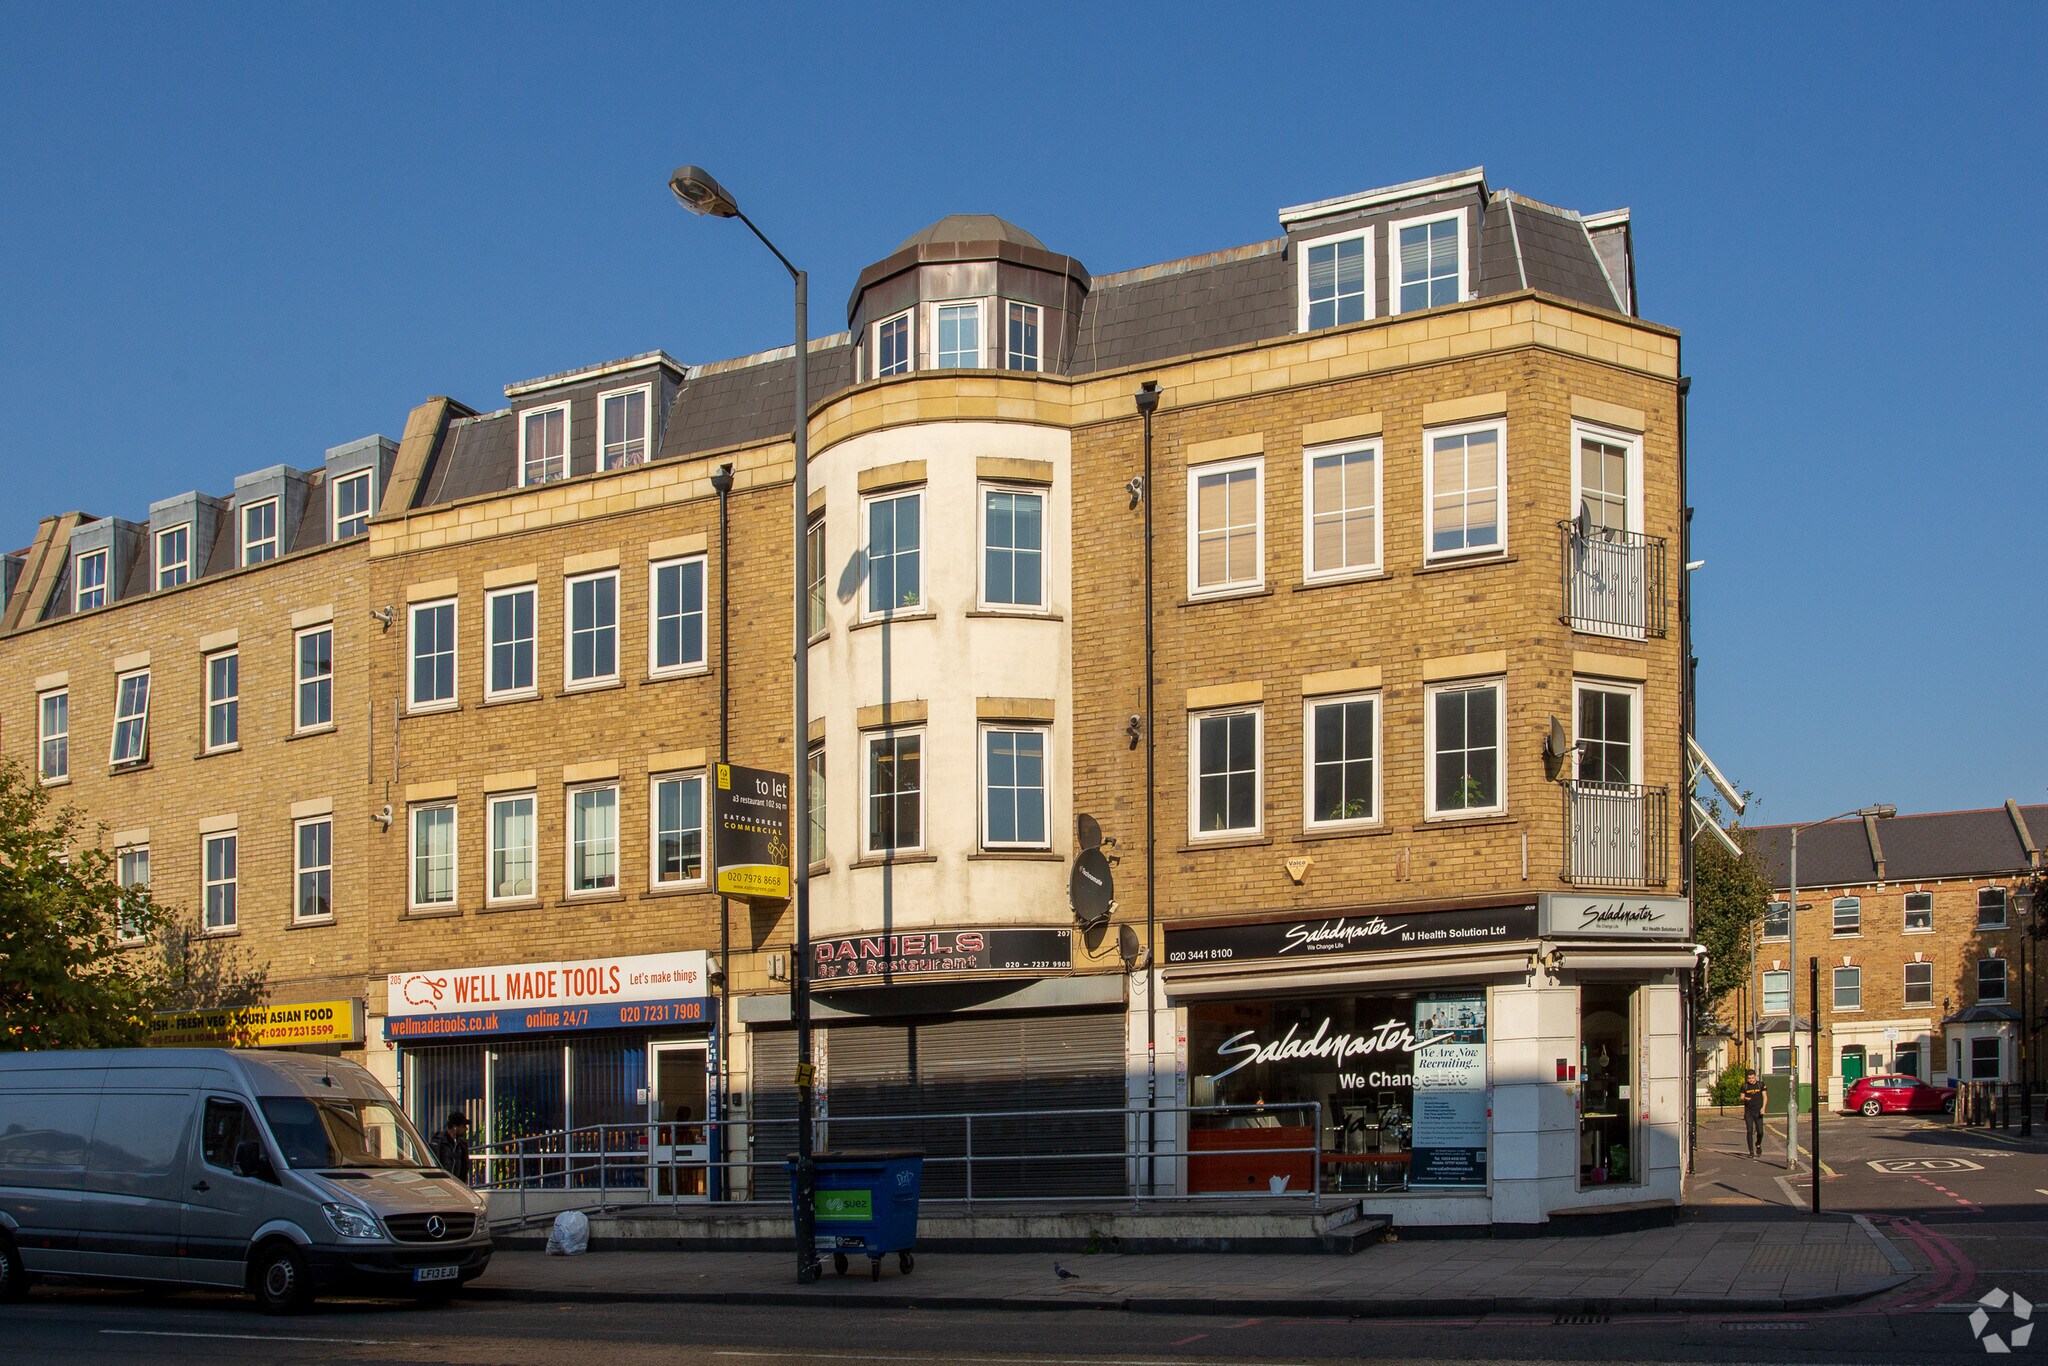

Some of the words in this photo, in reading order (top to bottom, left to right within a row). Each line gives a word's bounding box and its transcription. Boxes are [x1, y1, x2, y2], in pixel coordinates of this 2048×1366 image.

[756, 778, 769, 795] to
[772, 778, 787, 798] let
[732, 794, 740, 802] a3
[740, 797, 765, 806] restaurant
[766, 800, 774, 808] 102
[724, 814, 752, 822] EATON
[756, 818, 782, 827] GREEN
[724, 822, 782, 836] COMMERCIAL
[728, 872, 742, 882] 020
[744, 874, 762, 884] 7978
[764, 876, 782, 886] 8668
[1578, 902, 1666, 930] Saladmaster
[1057, 930, 1071, 938] 207
[1279, 917, 1408, 954] Saladmaster
[1402, 931, 1416, 942] MJ
[1417, 929, 1447, 941] Health
[1449, 927, 1488, 939] Solution
[1490, 926, 1506, 936] Ltd
[815, 932, 985, 963] DANIELS
[1170, 952, 1186, 962] 020
[1188, 950, 1209, 961] 3441
[1210, 949, 1232, 960] 8100
[818, 963, 841, 979] Bar
[847, 960, 859, 975] &
[866, 955, 978, 973] Restaurant
[1052, 960, 1071, 968] 9908
[390, 975, 402, 986] 205
[454, 974, 500, 1004] WELL
[506, 969, 557, 1001] MADE
[562, 965, 620, 997] TOOLS
[630, 971, 649, 986] Let's
[650, 971, 672, 984] make
[673, 969, 698, 986] things
[176, 1018, 204, 1030] FRESH
[206, 1016, 226, 1028] VEG
[236, 1012, 267, 1026] SOUTH
[270, 1010, 301, 1024] ASIAN
[304, 1008, 333, 1021] FOOD
[390, 1012, 499, 1036] wellmadetools.co.uk
[525, 1010, 560, 1028] online
[562, 1008, 589, 1027] 24/7
[620, 1006, 640, 1023] 020
[643, 1004, 670, 1022] 7231
[673, 1003, 700, 1020] 7908
[270, 1027, 286, 1038] 020
[288, 1024, 334, 1037] 72315599
[1206, 1017, 1454, 1085] Saladmaster
[1420, 1048, 1435, 1058] We
[1436, 1048, 1454, 1058] Are
[1456, 1048, 1478, 1058] Now
[798, 1066, 814, 1085] H
[1339, 1073, 1365, 1089] We
[1368, 1071, 1432, 1091] Change
[1886, 1160, 1961, 1170] 20
[844, 1200, 867, 1208] suez
[420, 1269, 440, 1280] LF13
